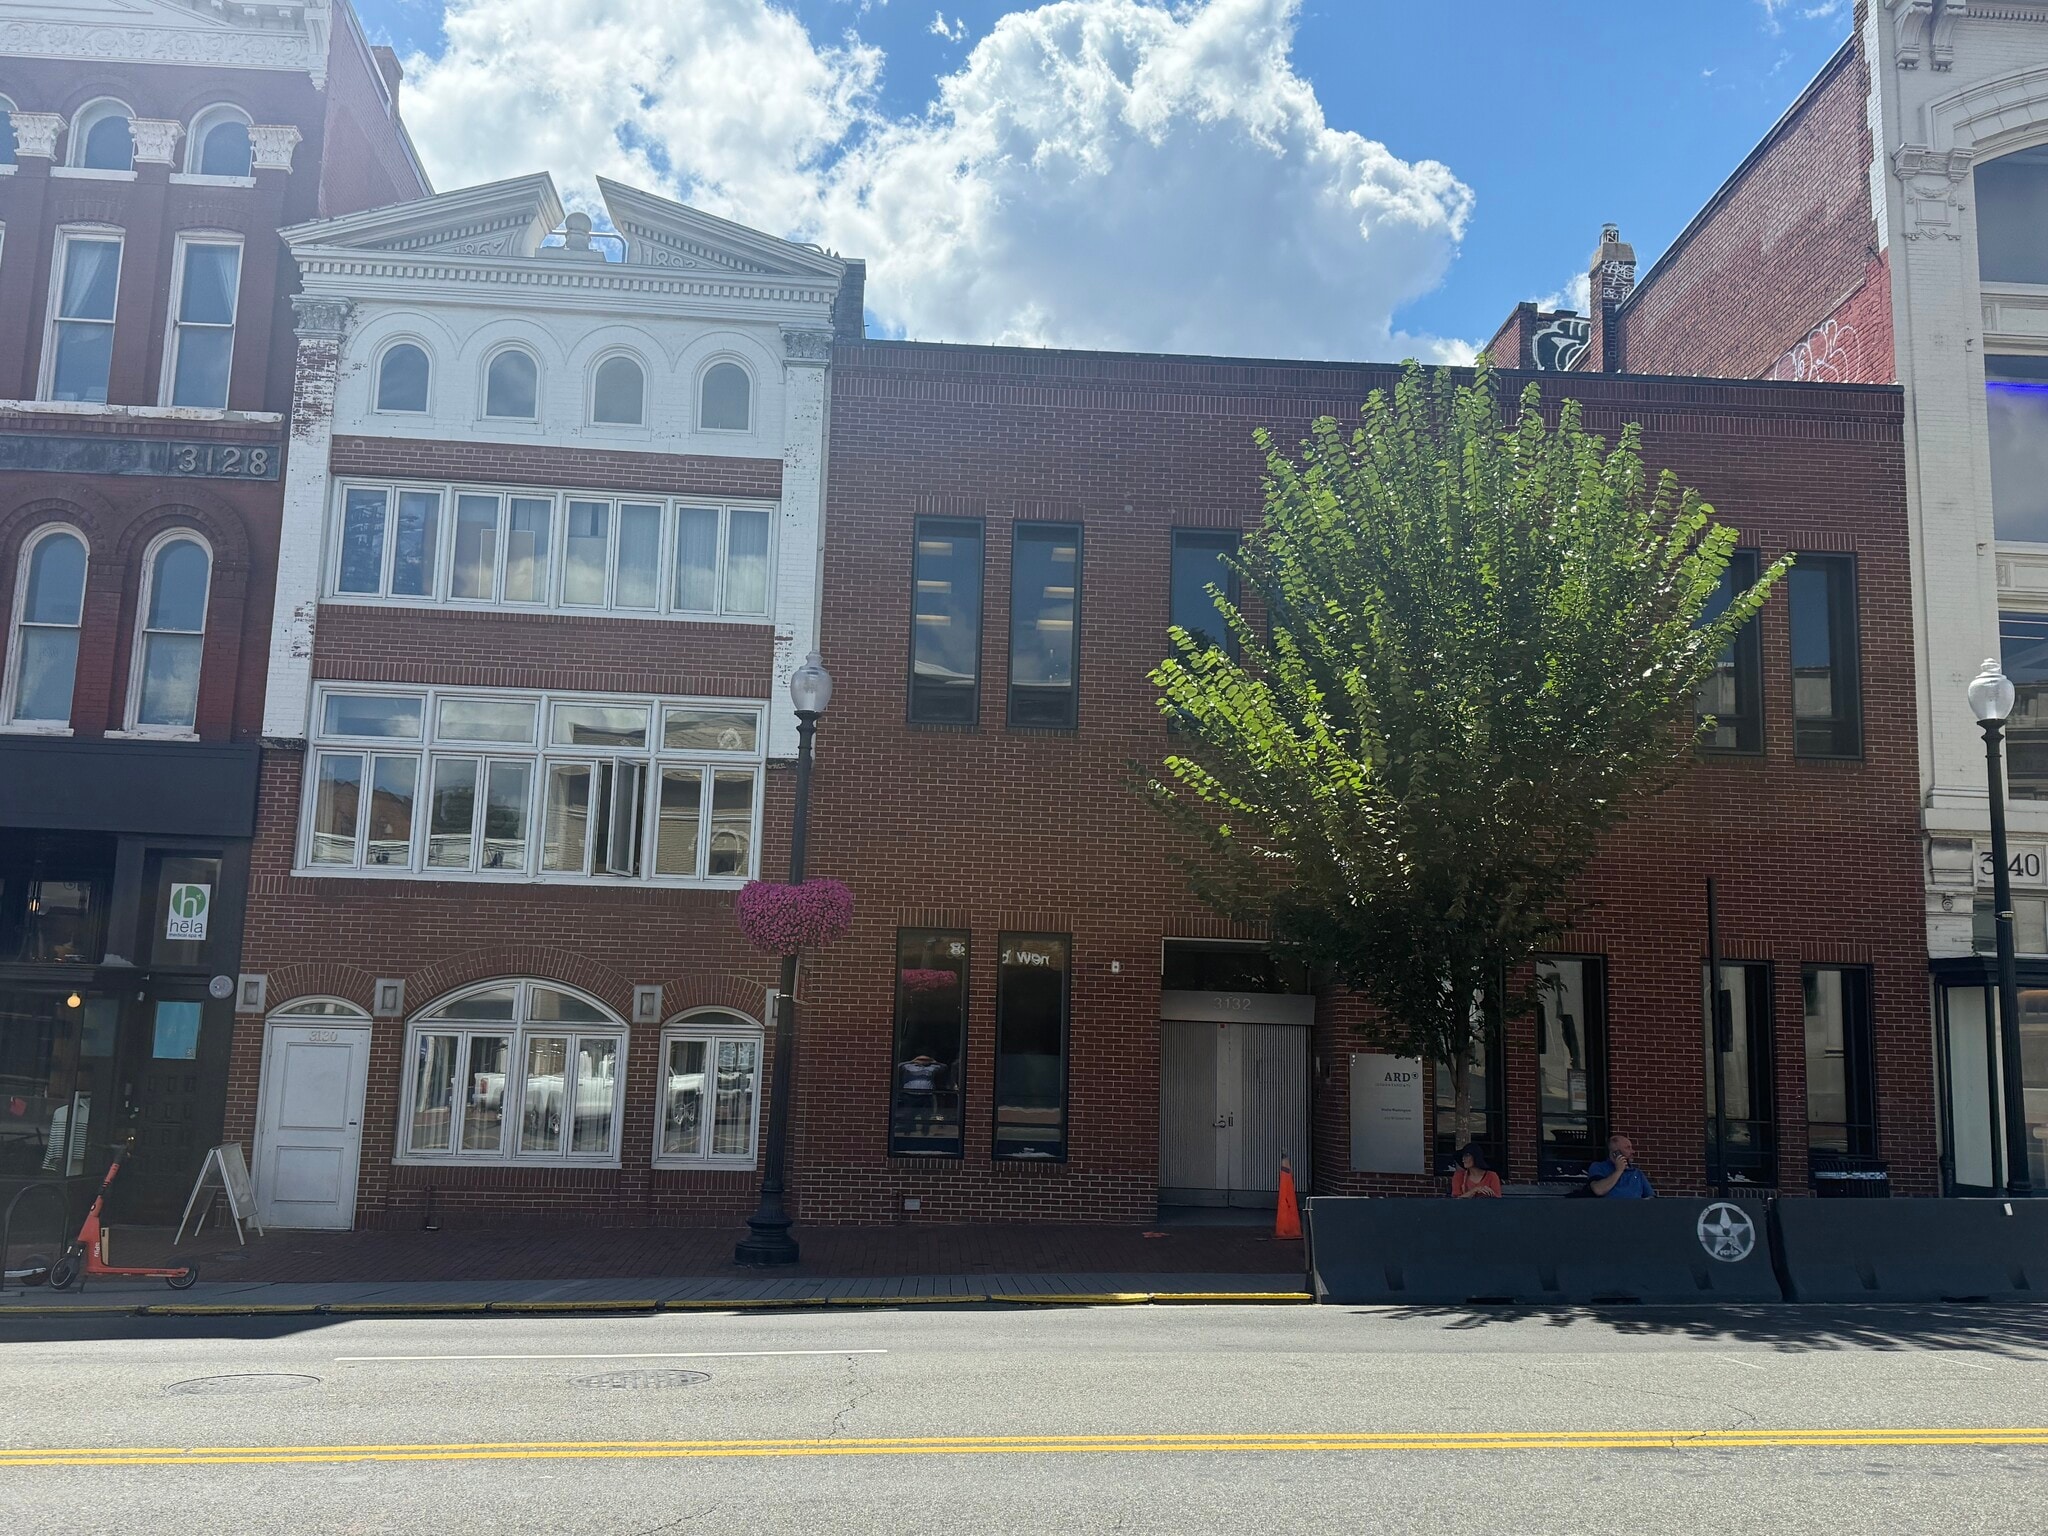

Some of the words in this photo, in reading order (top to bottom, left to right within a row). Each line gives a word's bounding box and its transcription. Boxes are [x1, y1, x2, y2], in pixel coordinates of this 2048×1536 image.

[178, 447, 269, 476] 3128
[1980, 851, 2040, 877] 340
[170, 918, 203, 934] hēla
[1214, 997, 1251, 1010] 3132
[309, 1030, 338, 1042] 3130
[1384, 1072, 1411, 1082] ARD
